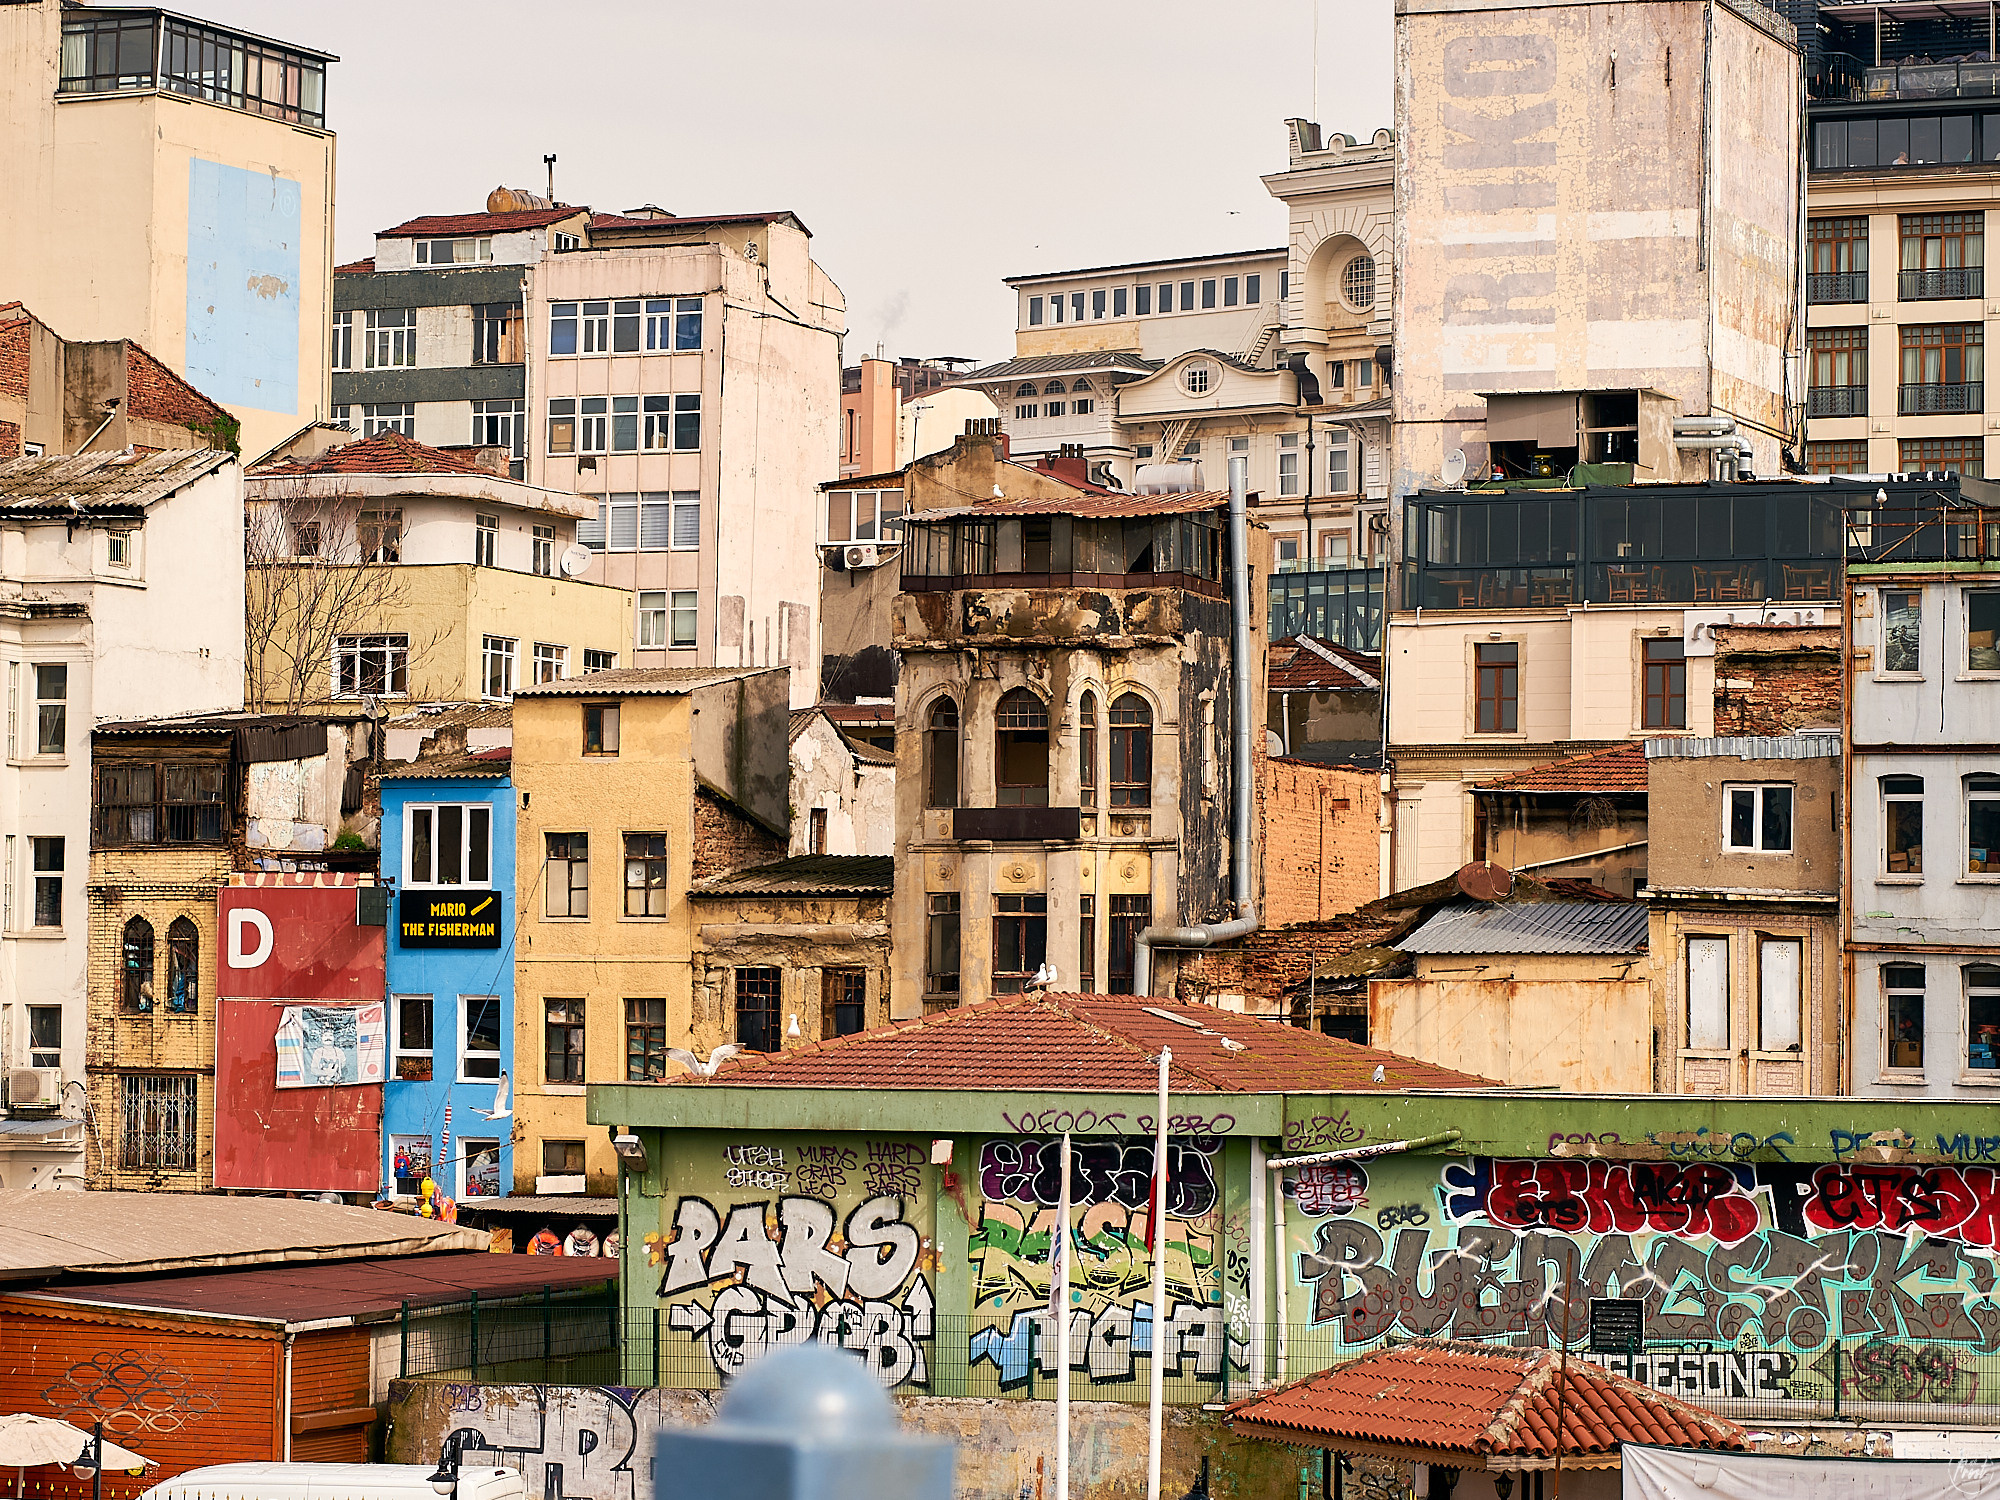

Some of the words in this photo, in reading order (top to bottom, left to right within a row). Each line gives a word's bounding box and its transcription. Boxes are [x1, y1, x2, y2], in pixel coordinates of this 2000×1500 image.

[430, 902, 466, 917] MARIO
[228, 907, 274, 969] D
[402, 922, 425, 936] THE
[428, 922, 495, 937] FISHERMAN
[865, 1140, 927, 1166] HARD
[796, 1163, 847, 1186] GRAB
[862, 1162, 922, 1188] PARS
[657, 1195, 920, 1301] PARS
